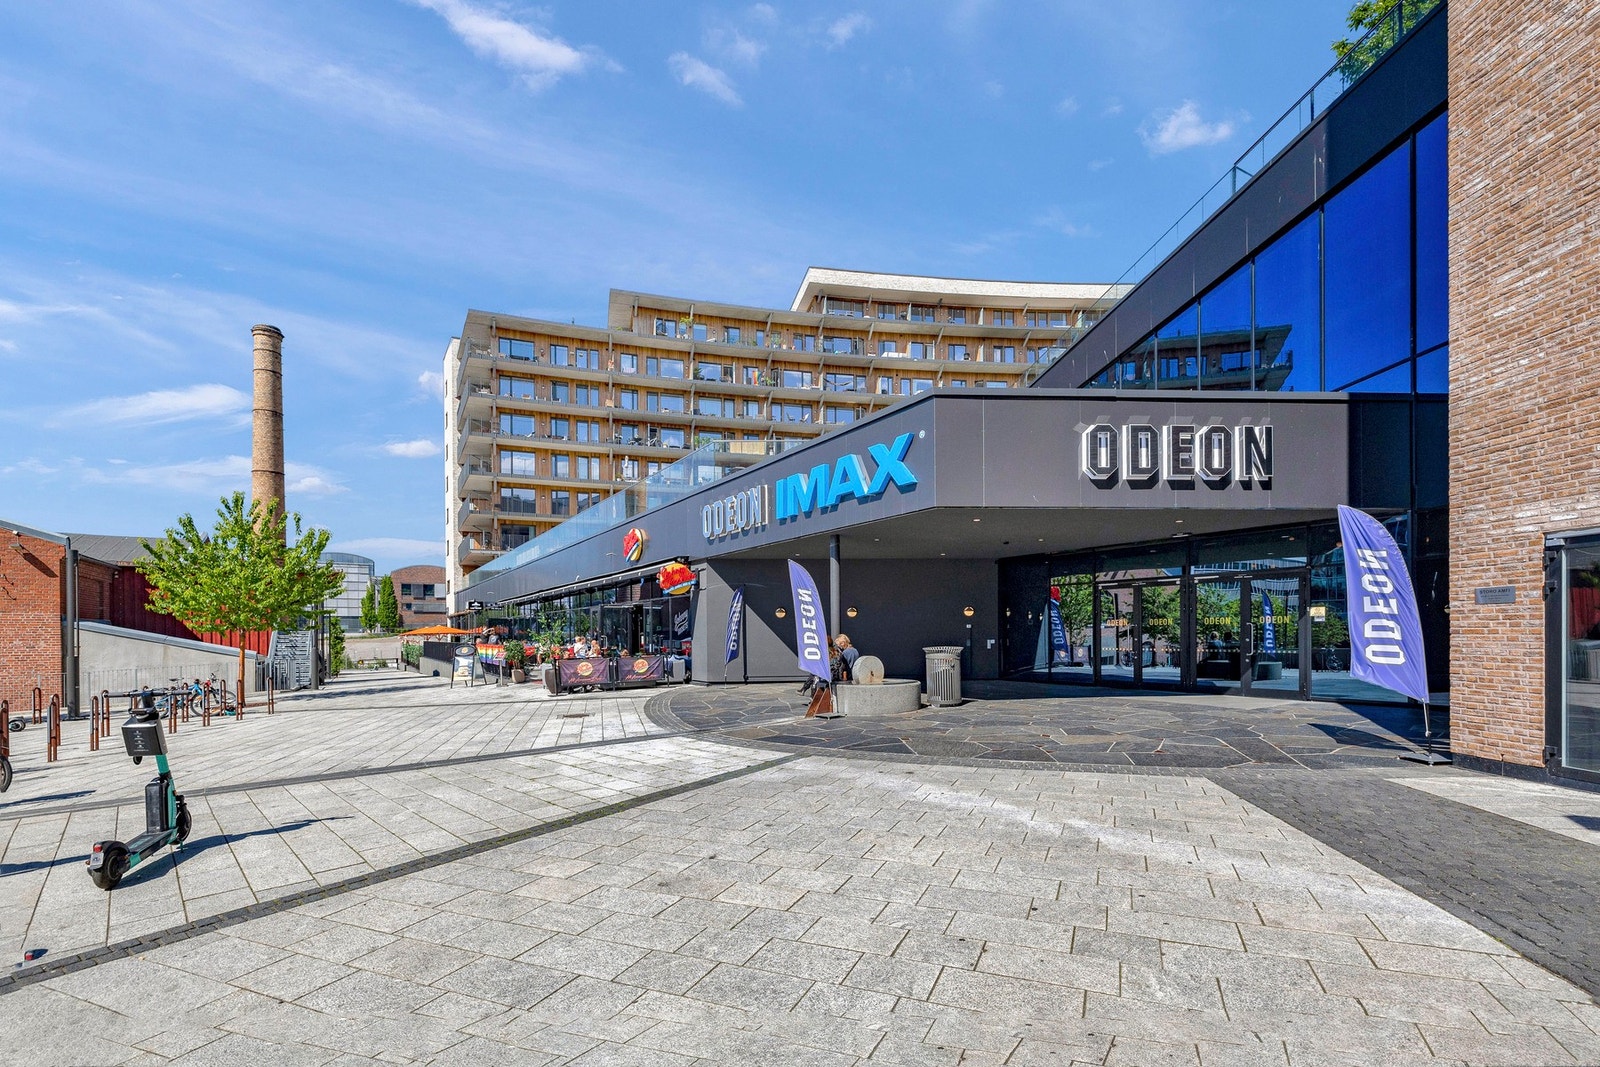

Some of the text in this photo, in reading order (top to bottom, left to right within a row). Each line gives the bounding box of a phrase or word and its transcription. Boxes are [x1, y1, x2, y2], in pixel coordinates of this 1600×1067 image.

[1082, 424, 1274, 481] ODEON
[702, 432, 918, 540] ODEON IMAX
[1106, 618, 1128, 627] ODEON
[1149, 618, 1174, 626] ODEON
[1204, 617, 1231, 625] ODEON
[1259, 615, 1290, 624] ODEON
